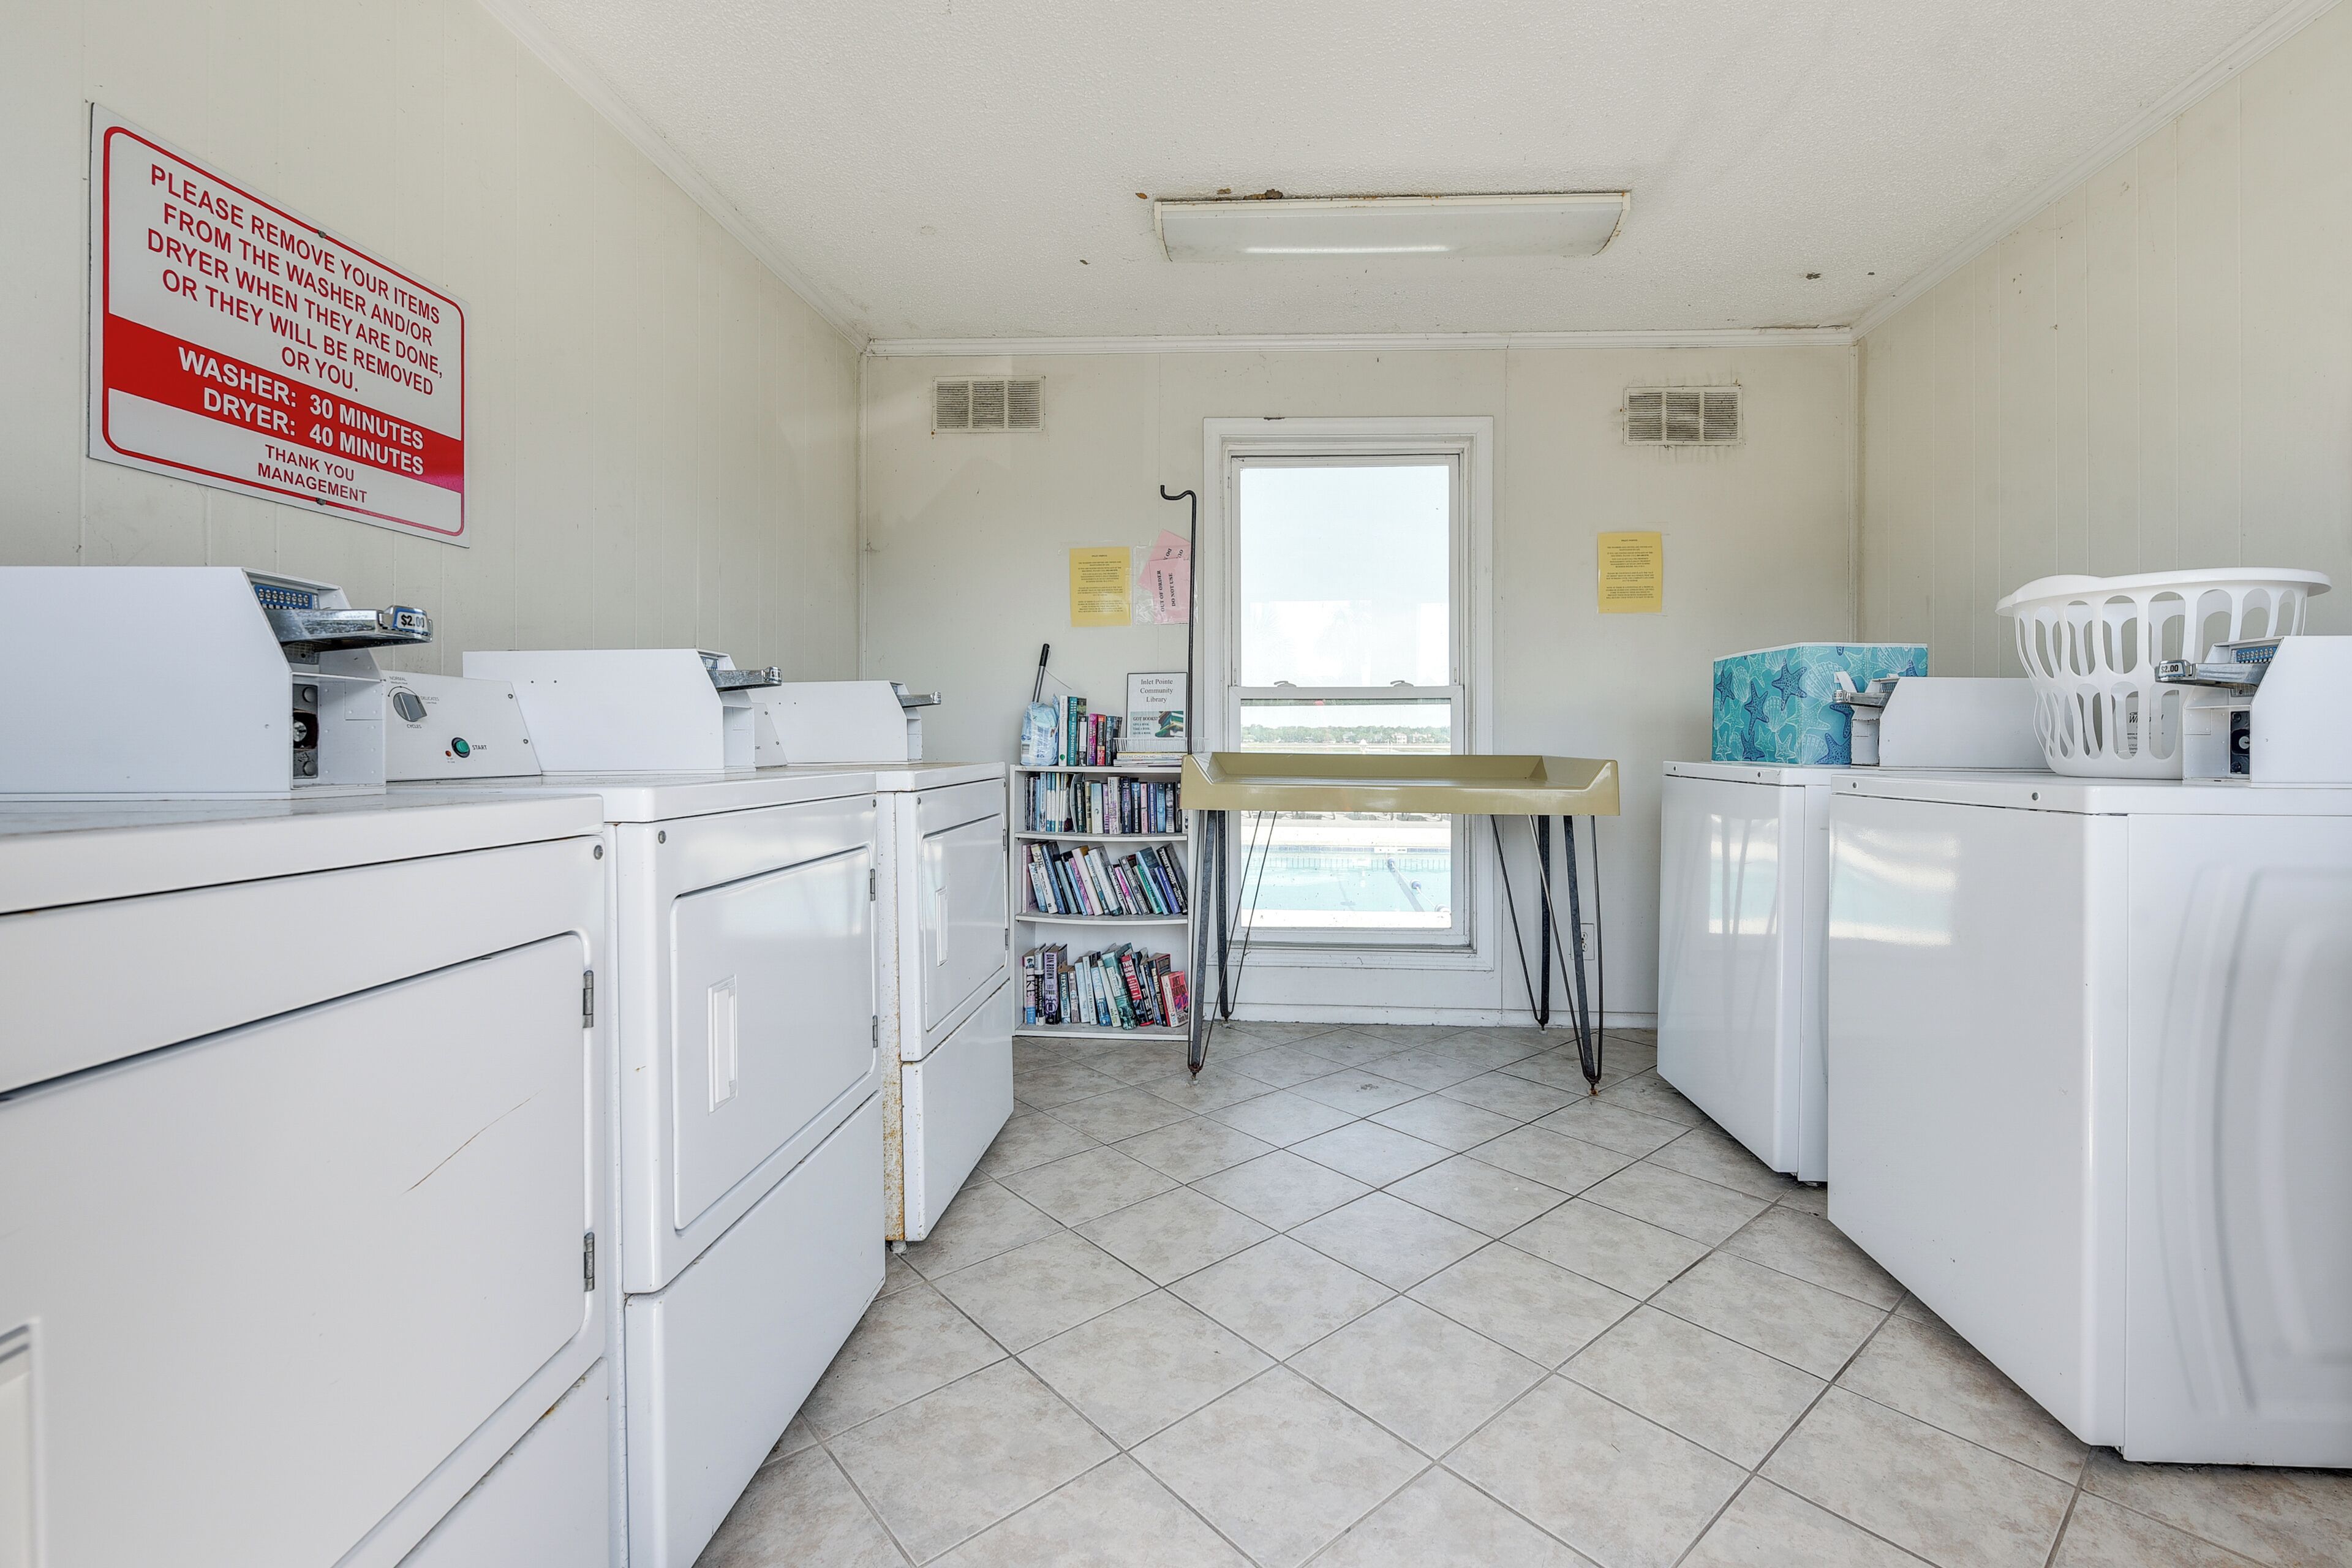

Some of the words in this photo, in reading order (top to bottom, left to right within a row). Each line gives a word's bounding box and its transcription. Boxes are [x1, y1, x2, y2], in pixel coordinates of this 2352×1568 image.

[152, 164, 243, 229] PLEASE
[252, 215, 335, 273] REMOVE
[341, 260, 389, 300] YOUR
[394, 287, 439, 324] ITEMS
[164, 203, 230, 253] FROM
[239, 238, 279, 276] THE
[287, 261, 366, 316] WASHER
[371, 304, 432, 346] AND/OR
[148, 228, 229, 284] DRYER
[236, 267, 297, 312] WHEN
[304, 298, 353, 335] THEY
[356, 323, 390, 353] ARE
[396, 340, 442, 378] DONE,
[163, 270, 197, 301] OR
[205, 285, 263, 326] THEY
[270, 312, 317, 350] WILL
[324, 335, 347, 361] BE
[354, 348, 433, 395] REMOVED
[282, 347, 310, 374] OR
[315, 358, 358, 392] YOU.
[178, 346, 296, 407] WASHER:
[310, 394, 333, 420] 30
[340, 404, 424, 450] MINUTES
[204, 387, 295, 436] DRYER:
[309, 424, 333, 447] 40
[340, 431, 424, 475] MINUTES
[258, 462, 367, 503] MANAGEMENT
[265, 444, 319, 472] THANK
[324, 461, 354, 481] YOU
[401, 614, 424, 628] $2.00
[1171, 598, 1176, 606] DO
[2161, 665, 2179, 674] $2.00
[1159, 851, 1170, 867] STUART
[1166, 867, 1177, 884] WOODS
[1046, 964, 1055, 979] BROWN
